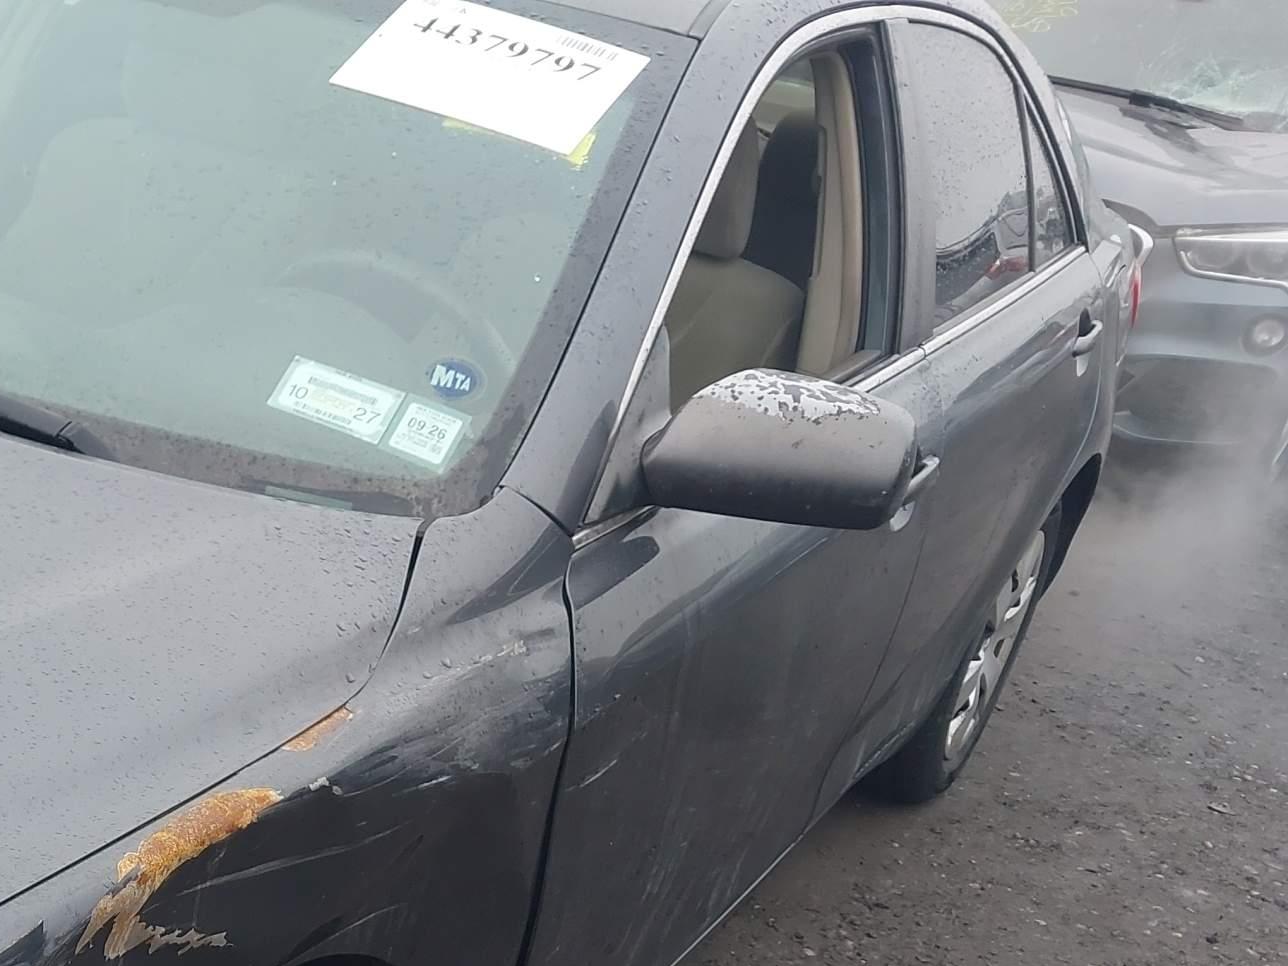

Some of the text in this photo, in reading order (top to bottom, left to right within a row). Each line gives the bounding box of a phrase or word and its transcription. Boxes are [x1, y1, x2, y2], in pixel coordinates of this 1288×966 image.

[413, 17, 601, 81] 44379797
[430, 364, 472, 392] MTA
[287, 383, 309, 400] 10
[352, 407, 381, 425] 27
[407, 416, 448, 441] 09 26
